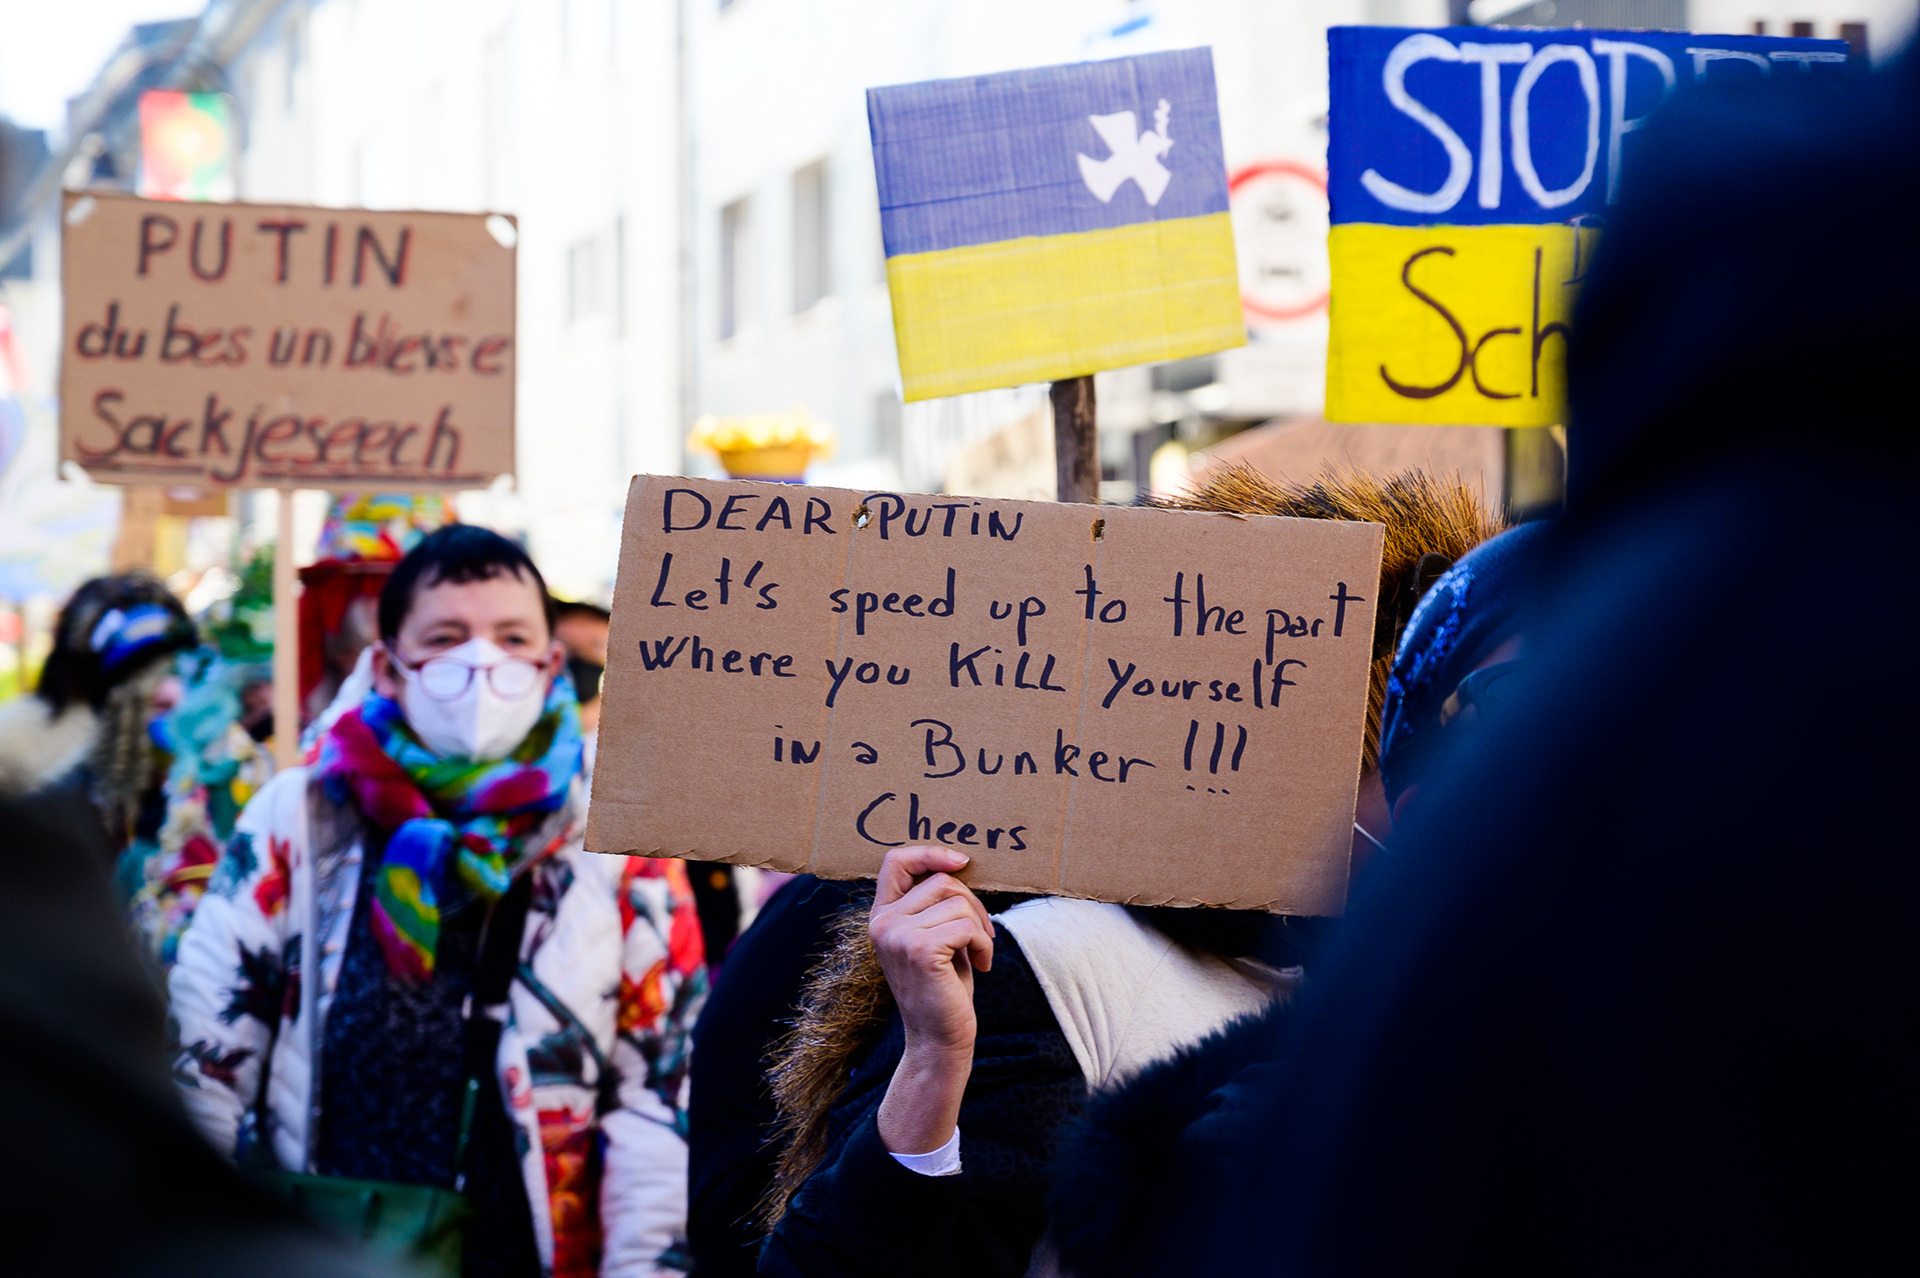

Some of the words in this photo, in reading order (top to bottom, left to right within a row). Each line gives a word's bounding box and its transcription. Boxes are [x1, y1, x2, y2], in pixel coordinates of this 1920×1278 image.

[1361, 32, 1677, 213] STOP
[138, 214, 412, 287] PUTIN
[77, 300, 148, 360] du
[160, 302, 252, 368] bes
[267, 325, 333, 369] un
[662, 489, 836, 534] DEAR
[651, 552, 780, 611] Let's
[830, 567, 955, 637] speed
[990, 597, 1046, 647] up
[1075, 565, 1127, 623] to
[1164, 572, 1247, 636] the
[1265, 581, 1366, 665] part
[825, 656, 911, 708] you
[851, 741, 879, 765] a
[911, 719, 1157, 784] Bunker
[856, 792, 1028, 851] Cheers
